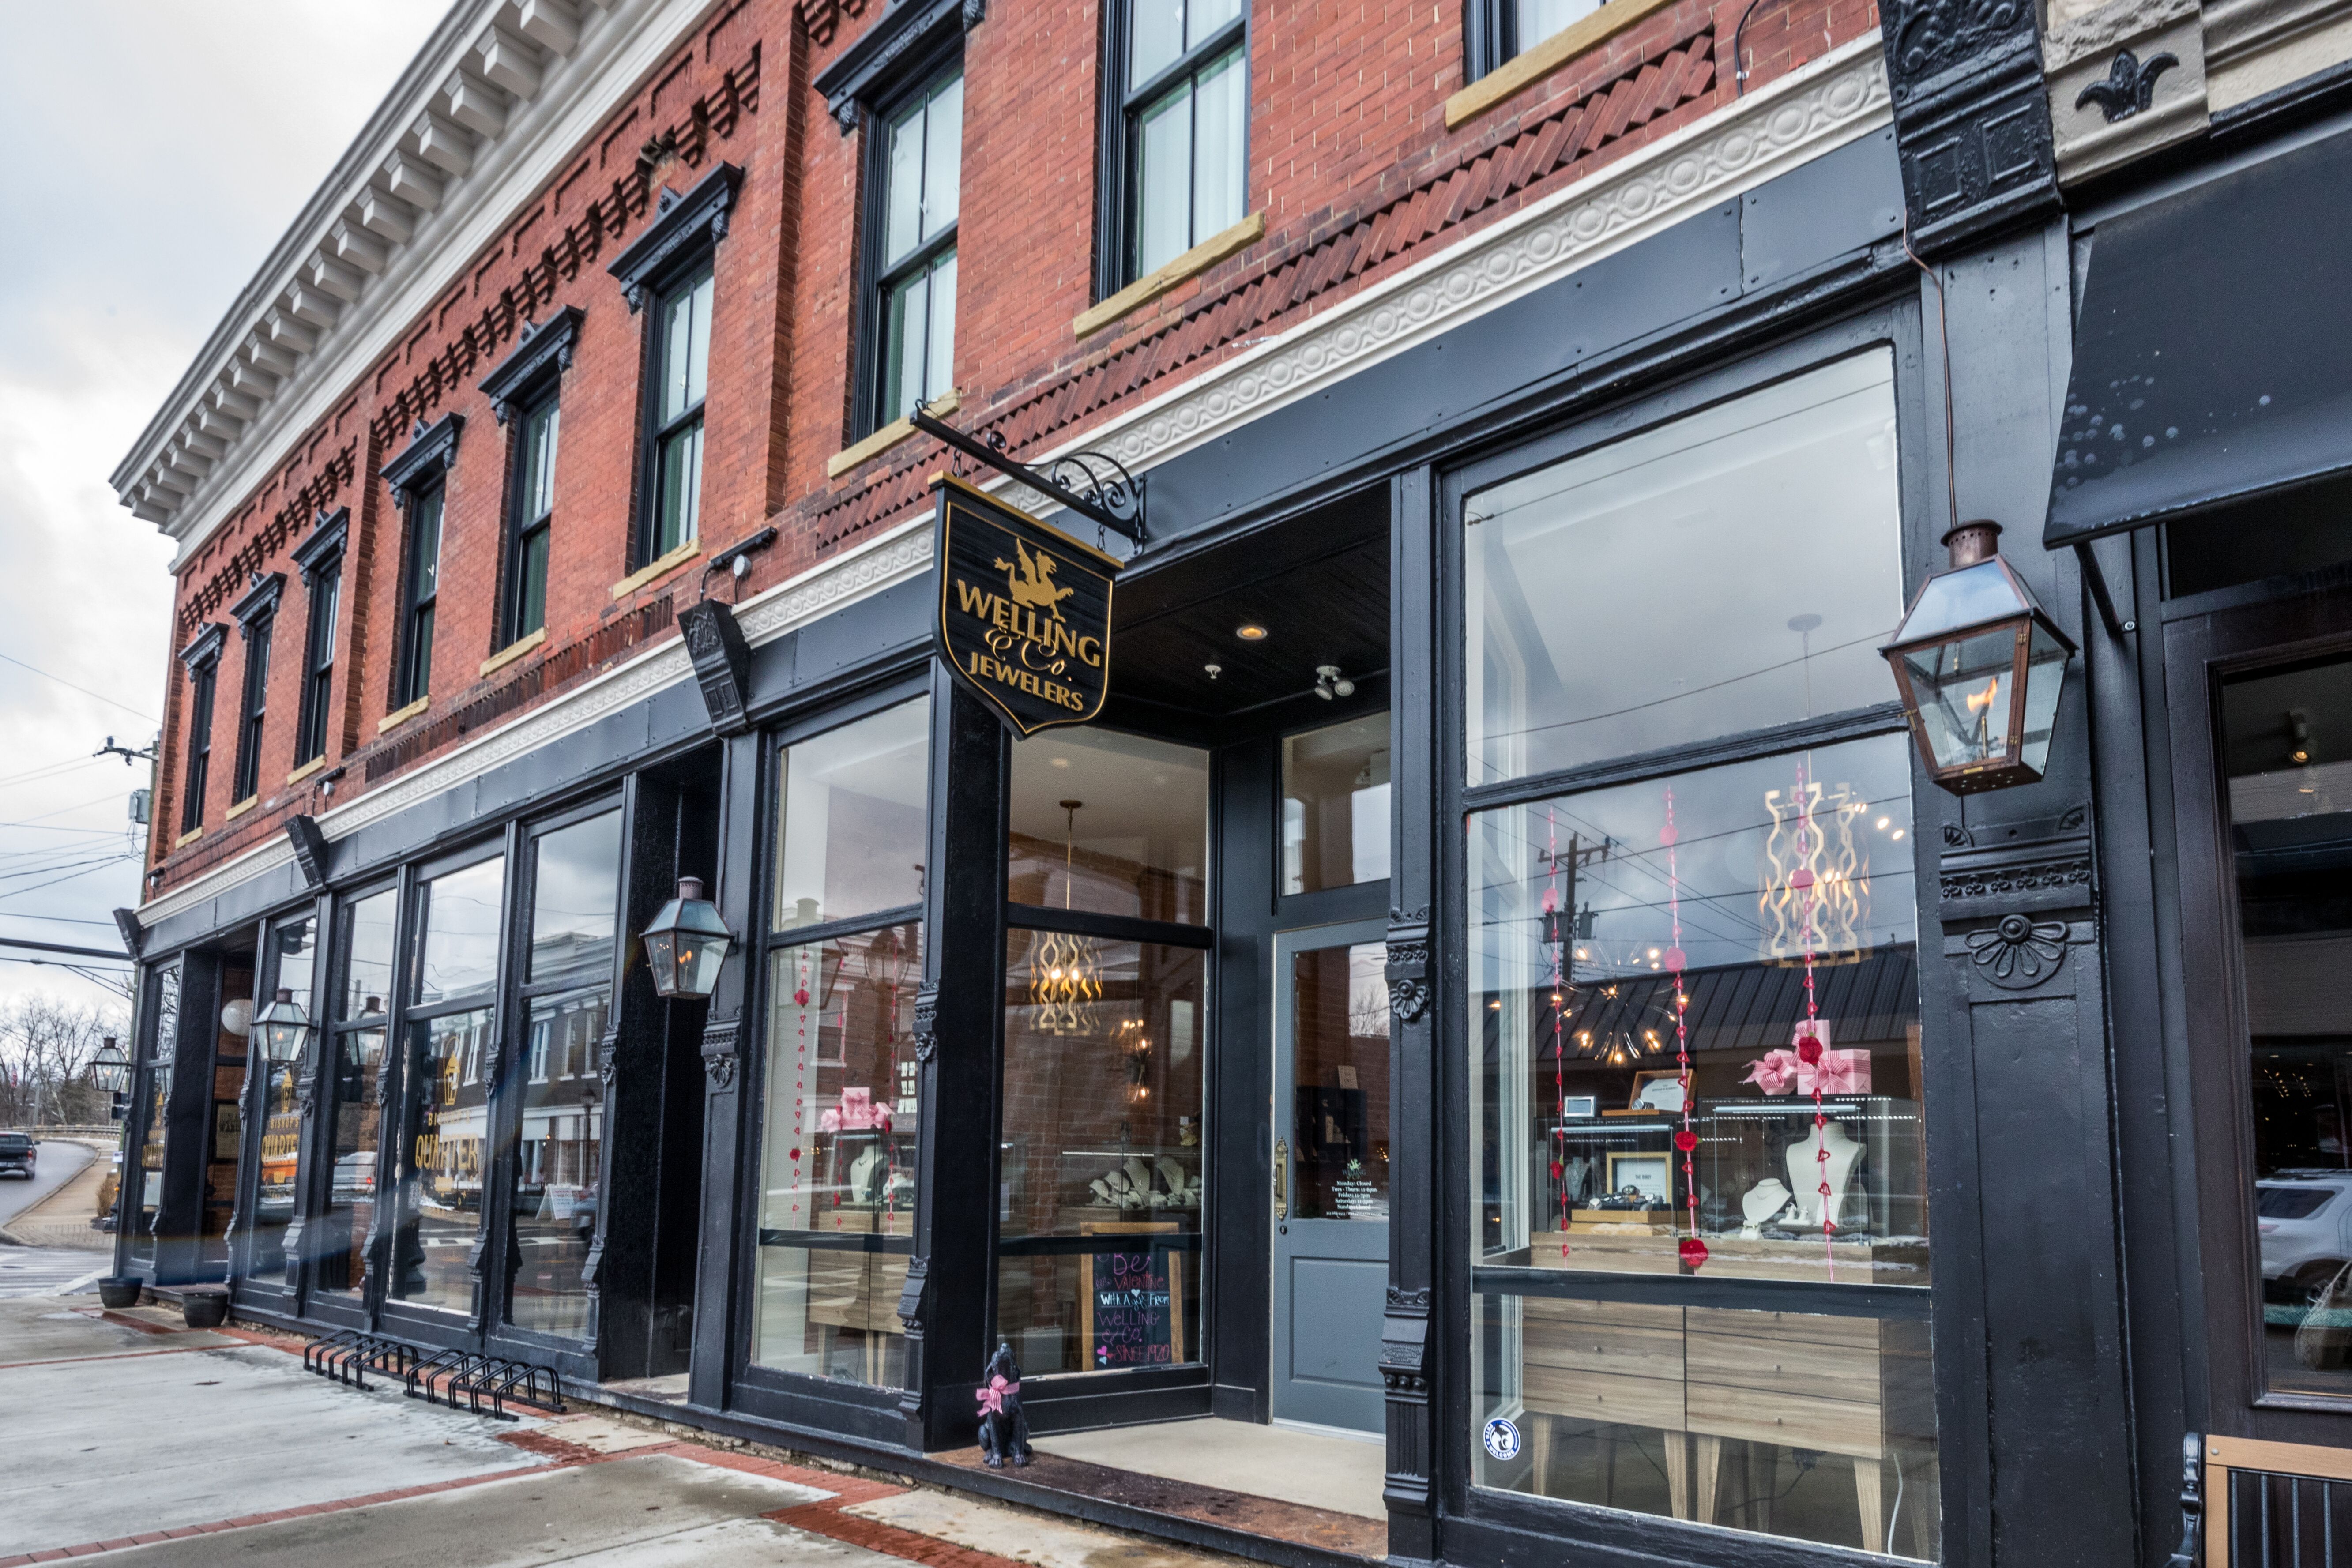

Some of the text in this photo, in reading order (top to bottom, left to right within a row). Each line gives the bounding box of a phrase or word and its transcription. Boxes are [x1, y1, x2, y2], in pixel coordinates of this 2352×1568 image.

[957, 579, 1101, 667] WELLING
[969, 651, 1084, 712] JEWELERS
[261, 1134, 299, 1164] QUARTE
[415, 1133, 478, 1171] QUARTER
[1114, 1253, 1150, 1275] Be
[1123, 1294, 1130, 1306] A
[1114, 1345, 1145, 1363] SINCE
[1489, 1445, 1515, 1458] WELCOME
